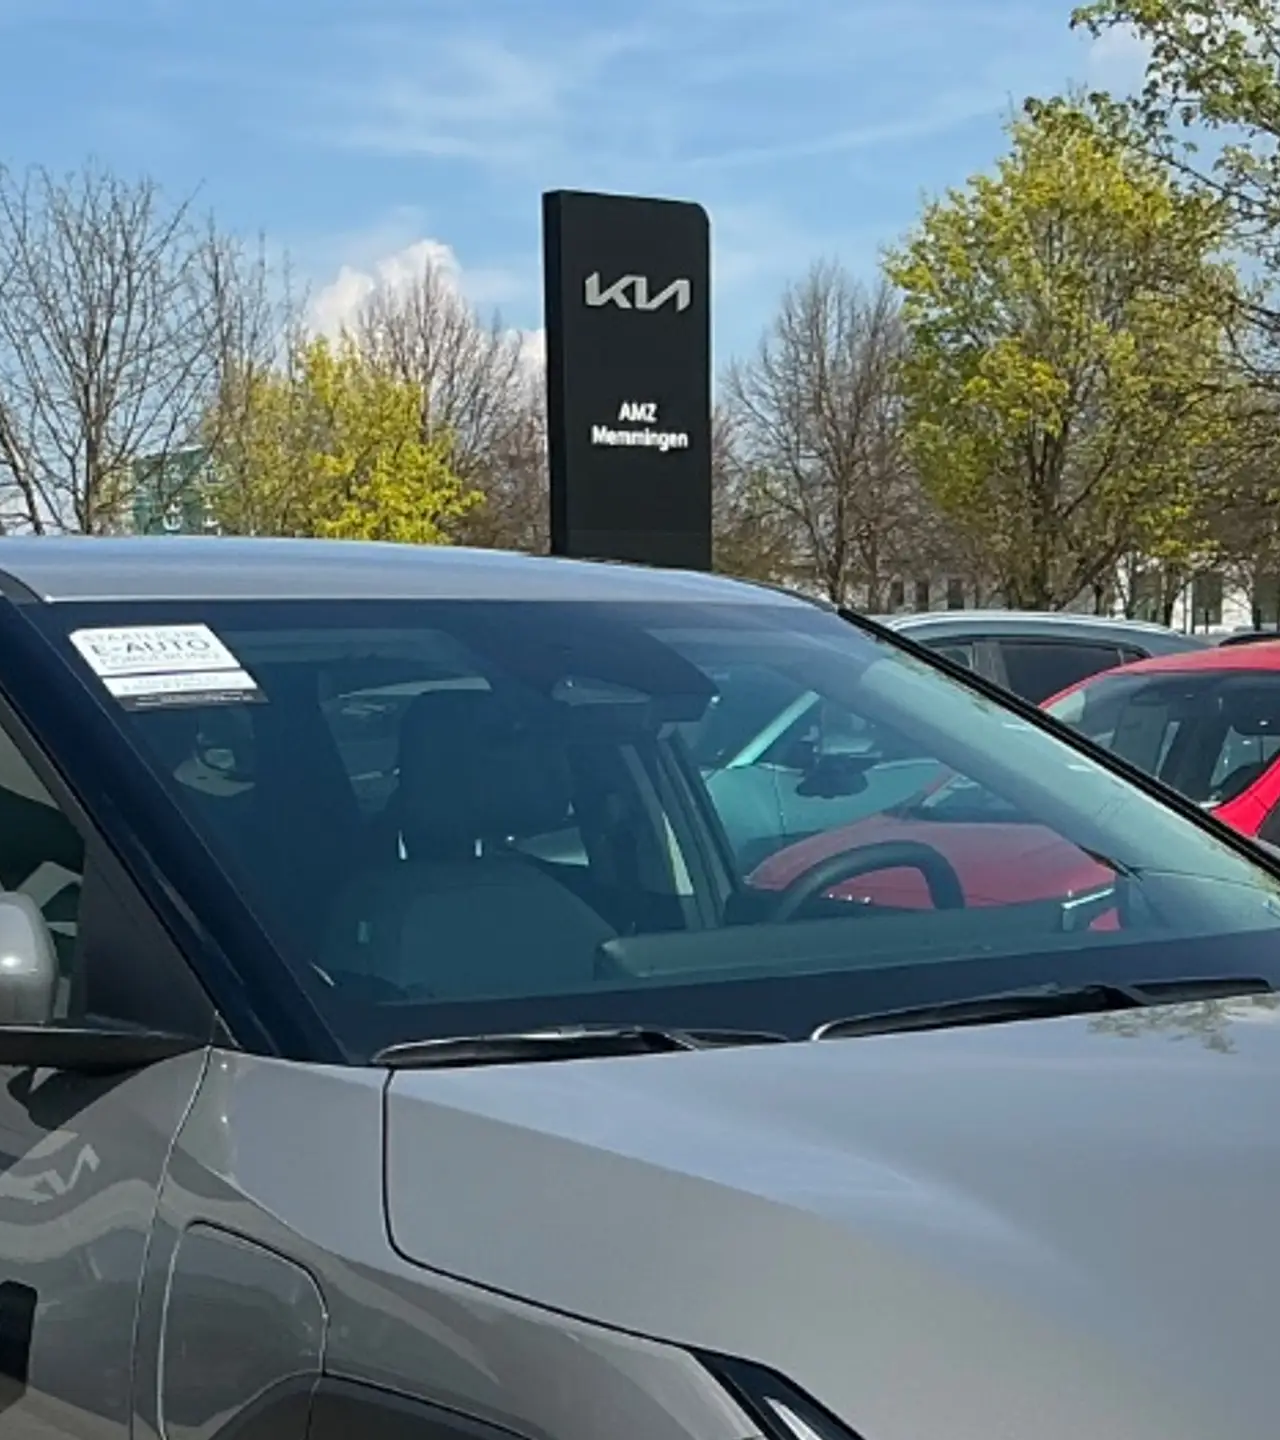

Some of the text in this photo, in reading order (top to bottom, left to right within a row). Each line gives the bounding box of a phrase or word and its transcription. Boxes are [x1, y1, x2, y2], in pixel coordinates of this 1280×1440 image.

[584, 271, 691, 312] KIA
[618, 400, 658, 423] AMZ
[591, 424, 690, 452] Memmingen
